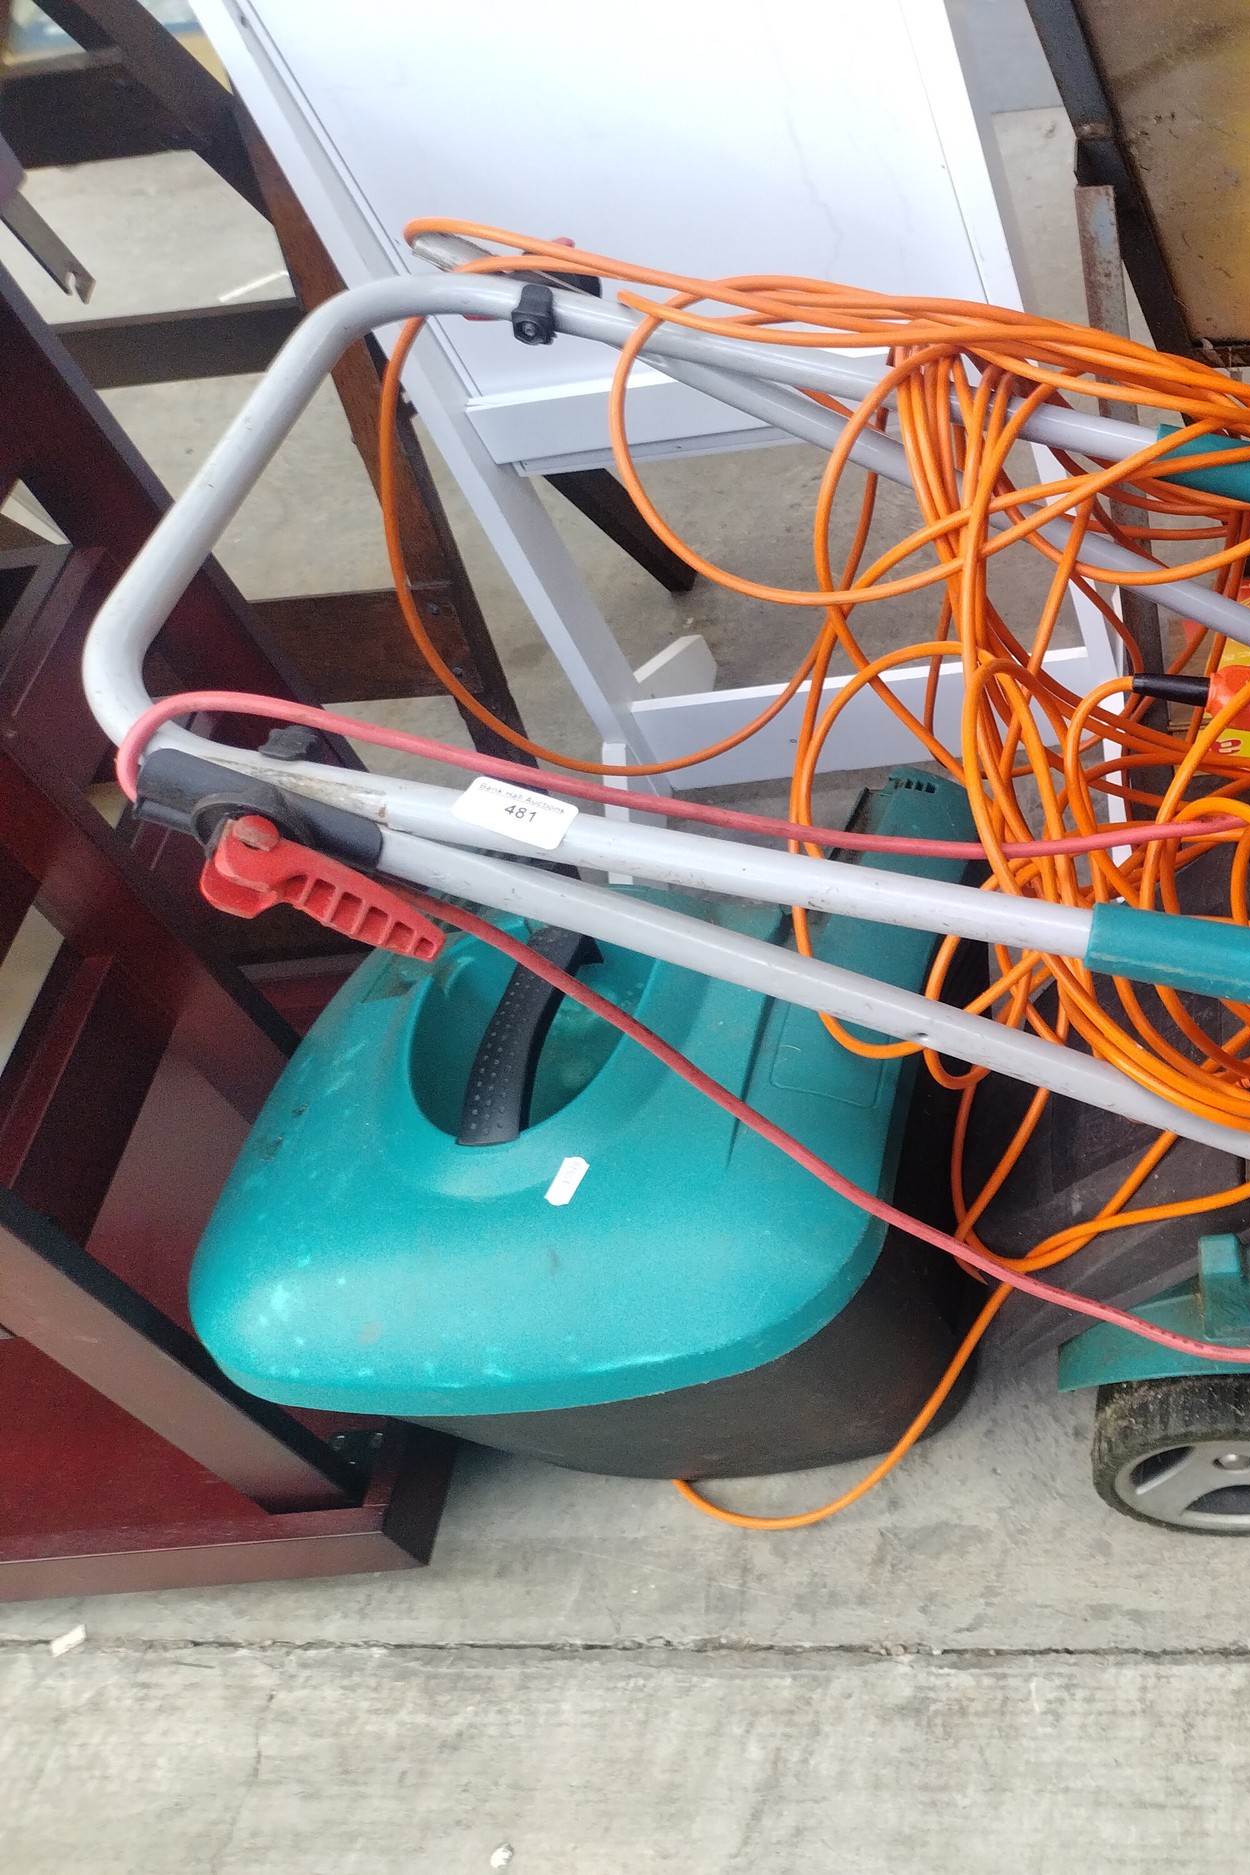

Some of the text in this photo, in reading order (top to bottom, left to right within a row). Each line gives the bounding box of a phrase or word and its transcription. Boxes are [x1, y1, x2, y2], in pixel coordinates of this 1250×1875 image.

[479, 782, 502, 794] Bank
[525, 797, 566, 814] Auctions
[504, 804, 537, 823] 481
